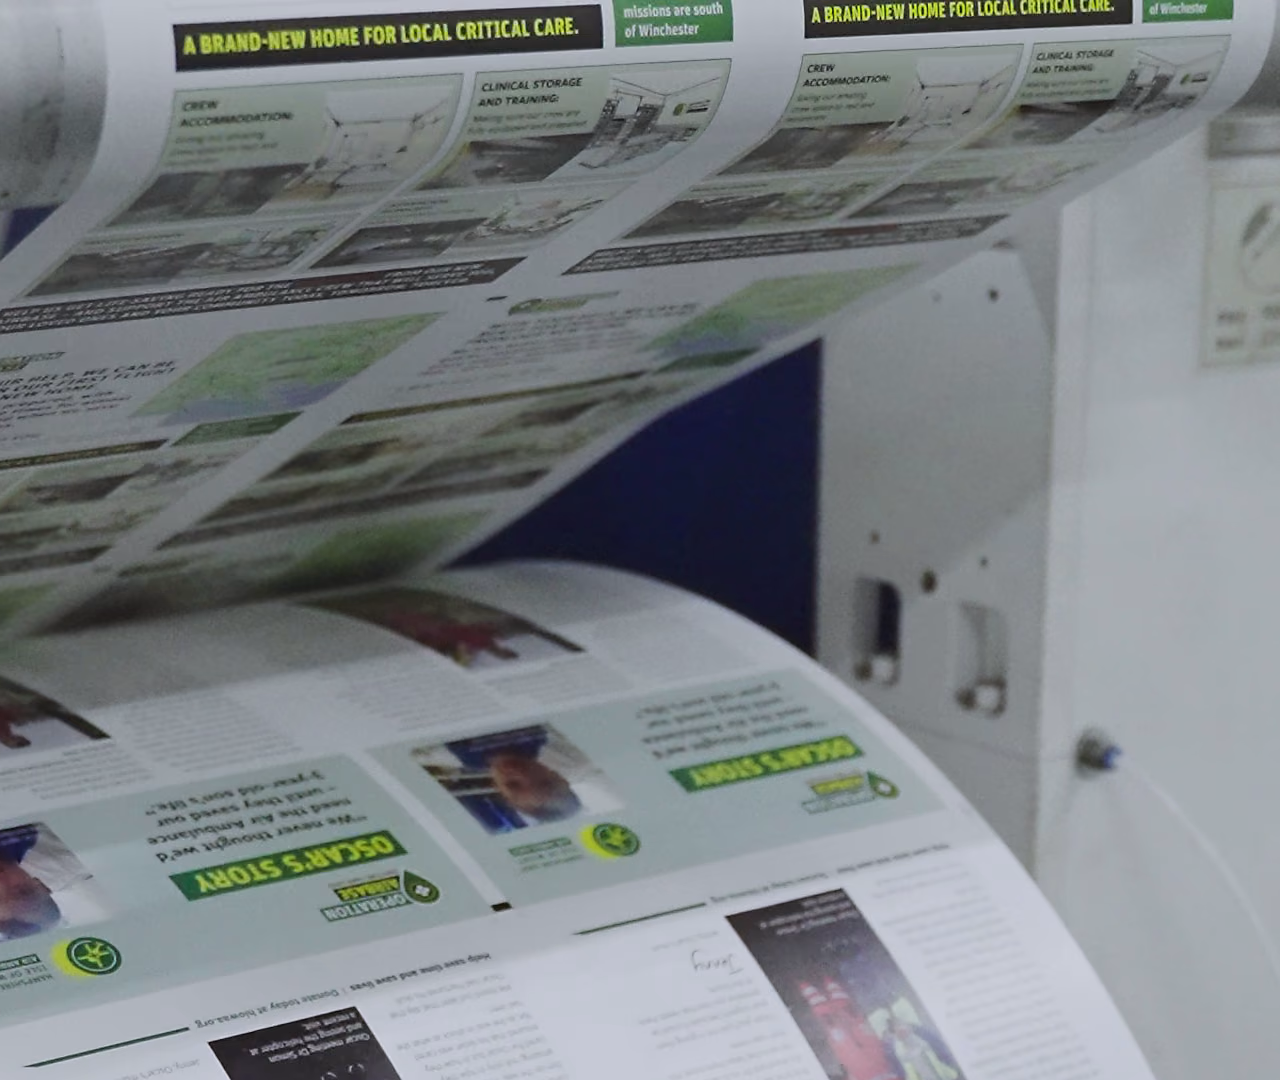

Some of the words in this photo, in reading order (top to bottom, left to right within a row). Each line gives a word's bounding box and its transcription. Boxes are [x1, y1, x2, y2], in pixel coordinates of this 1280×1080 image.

[622, 0, 672, 18] missions
[672, 3, 691, 16] are
[692, 0, 724, 15] south
[811, 8, 821, 23] A
[824, 2, 904, 22] BRAND-NEW
[908, 0, 944, 17] HOME
[948, 0, 975, 16] FOR
[979, 0, 1016, 16] LOCAL
[1018, 0, 1076, 14] CRITICAL
[182, 35, 196, 54] A
[199, 29, 306, 53] BRAND-NEW
[310, 26, 358, 47] HOME
[363, 24, 396, 44] FOR
[402, 23, 450, 42] LOCAL
[455, 19, 529, 40] CRITICAL
[533, 15, 579, 35] CARE.
[623, 23, 636, 38] of
[637, 22, 700, 37] Winchester
[806, 63, 836, 73] CREW
[480, 80, 529, 92] CLINICAL
[532, 76, 583, 89] STORAGE
[477, 96, 502, 107] AND
[281, 834, 394, 872] OSCAR’S
[196, 857, 283, 891] STORY
